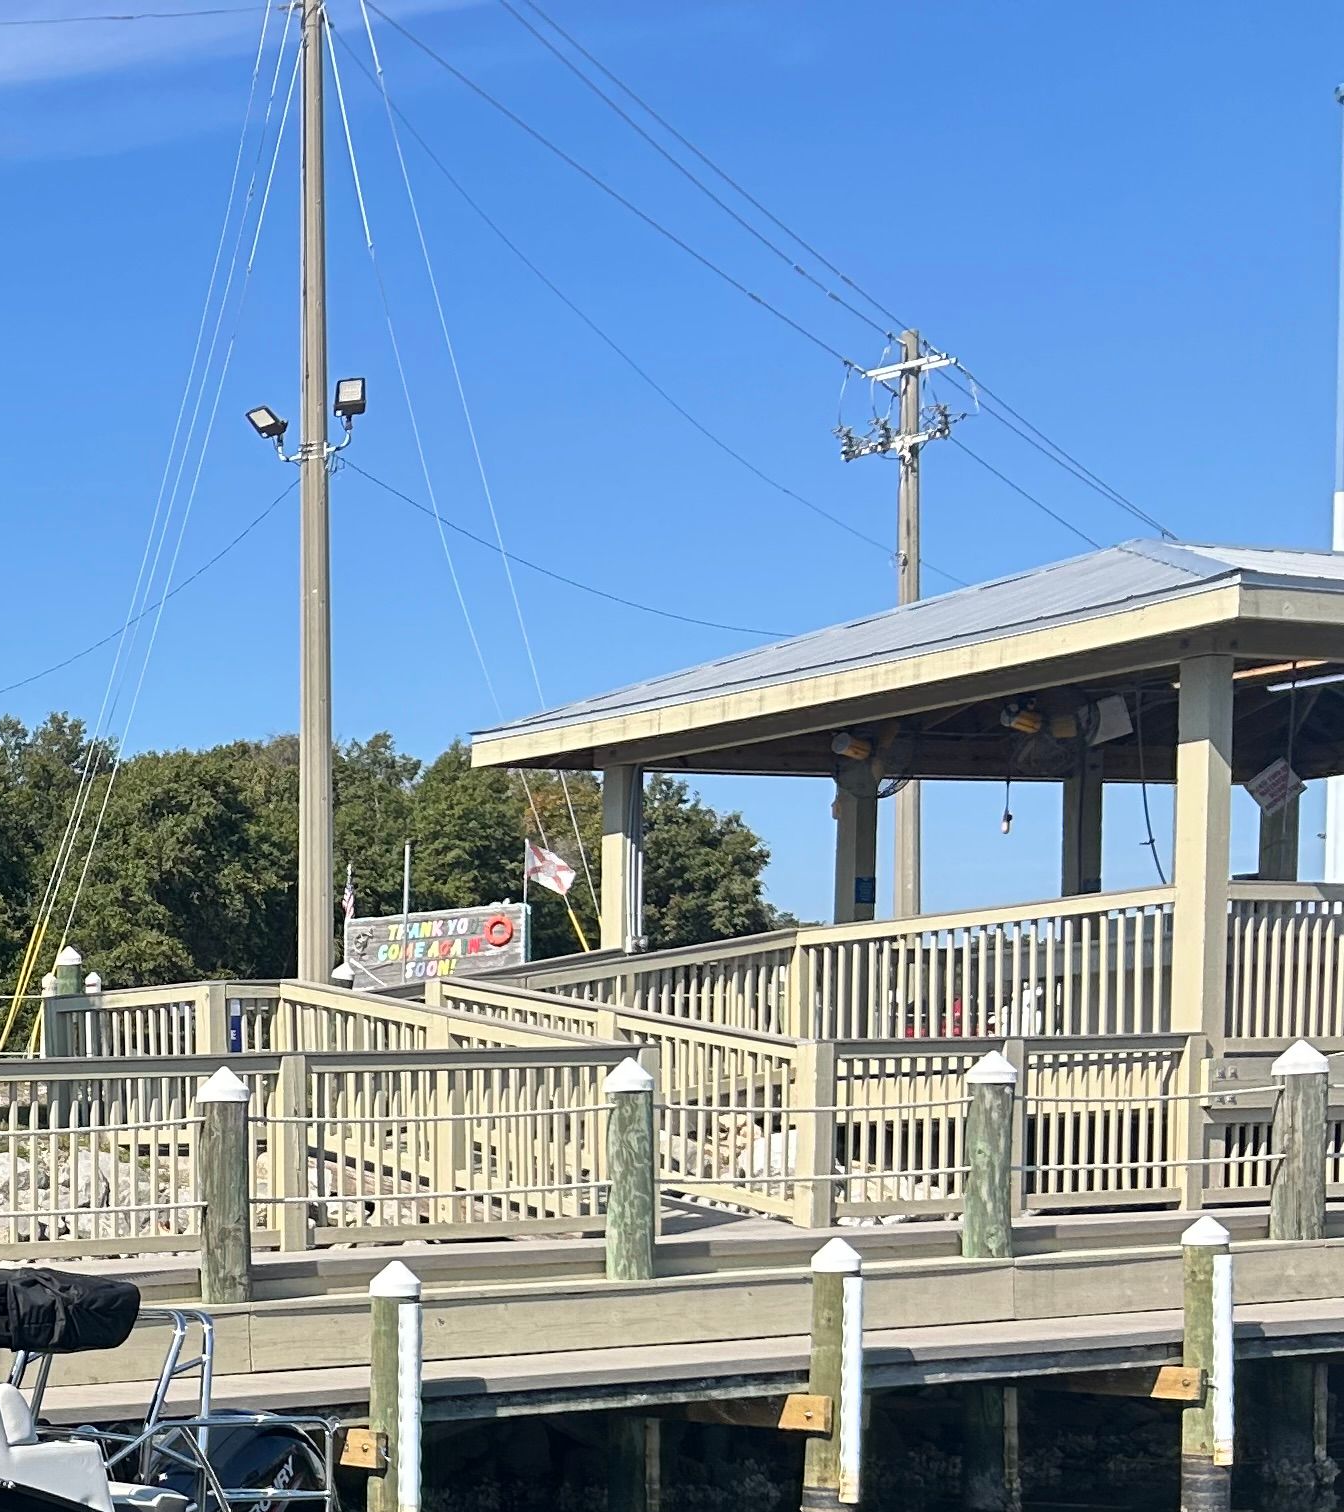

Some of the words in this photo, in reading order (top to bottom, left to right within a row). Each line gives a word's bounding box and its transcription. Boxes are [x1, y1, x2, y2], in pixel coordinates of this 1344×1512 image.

[387, 919, 443, 941] THANK
[447, 917, 481, 937] YOU
[377, 941, 425, 962] COME
[427, 937, 482, 959] AGAIN
[404, 958, 457, 979] SOON!
